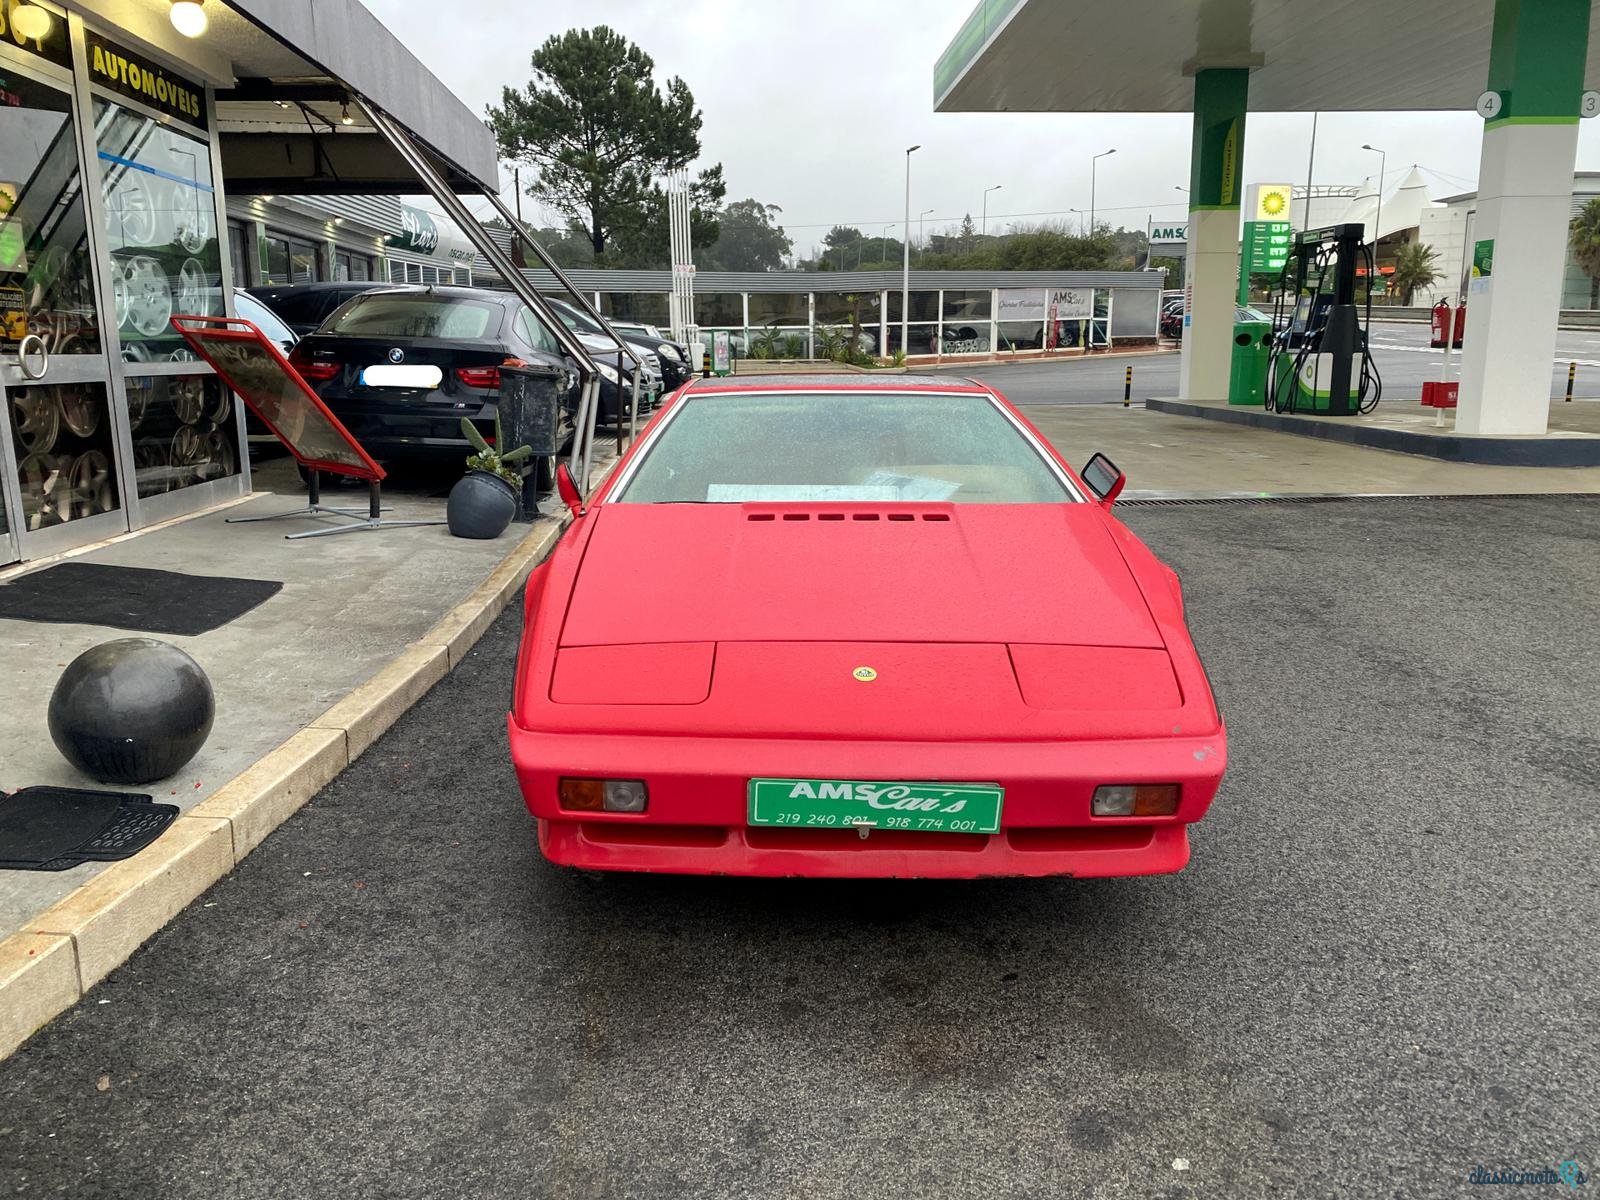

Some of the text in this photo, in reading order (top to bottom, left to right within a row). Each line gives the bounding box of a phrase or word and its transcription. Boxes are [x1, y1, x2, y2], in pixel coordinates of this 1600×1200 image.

[93, 45, 200, 118] AUTOMÓVEIS
[1484, 97, 1494, 112] 4
[1585, 97, 1596, 112] 3
[775, 813, 801, 824] 219
[806, 814, 836, 825] 240
[886, 817, 912, 828] 918
[918, 818, 944, 829] 774
[950, 820, 977, 831] 001
